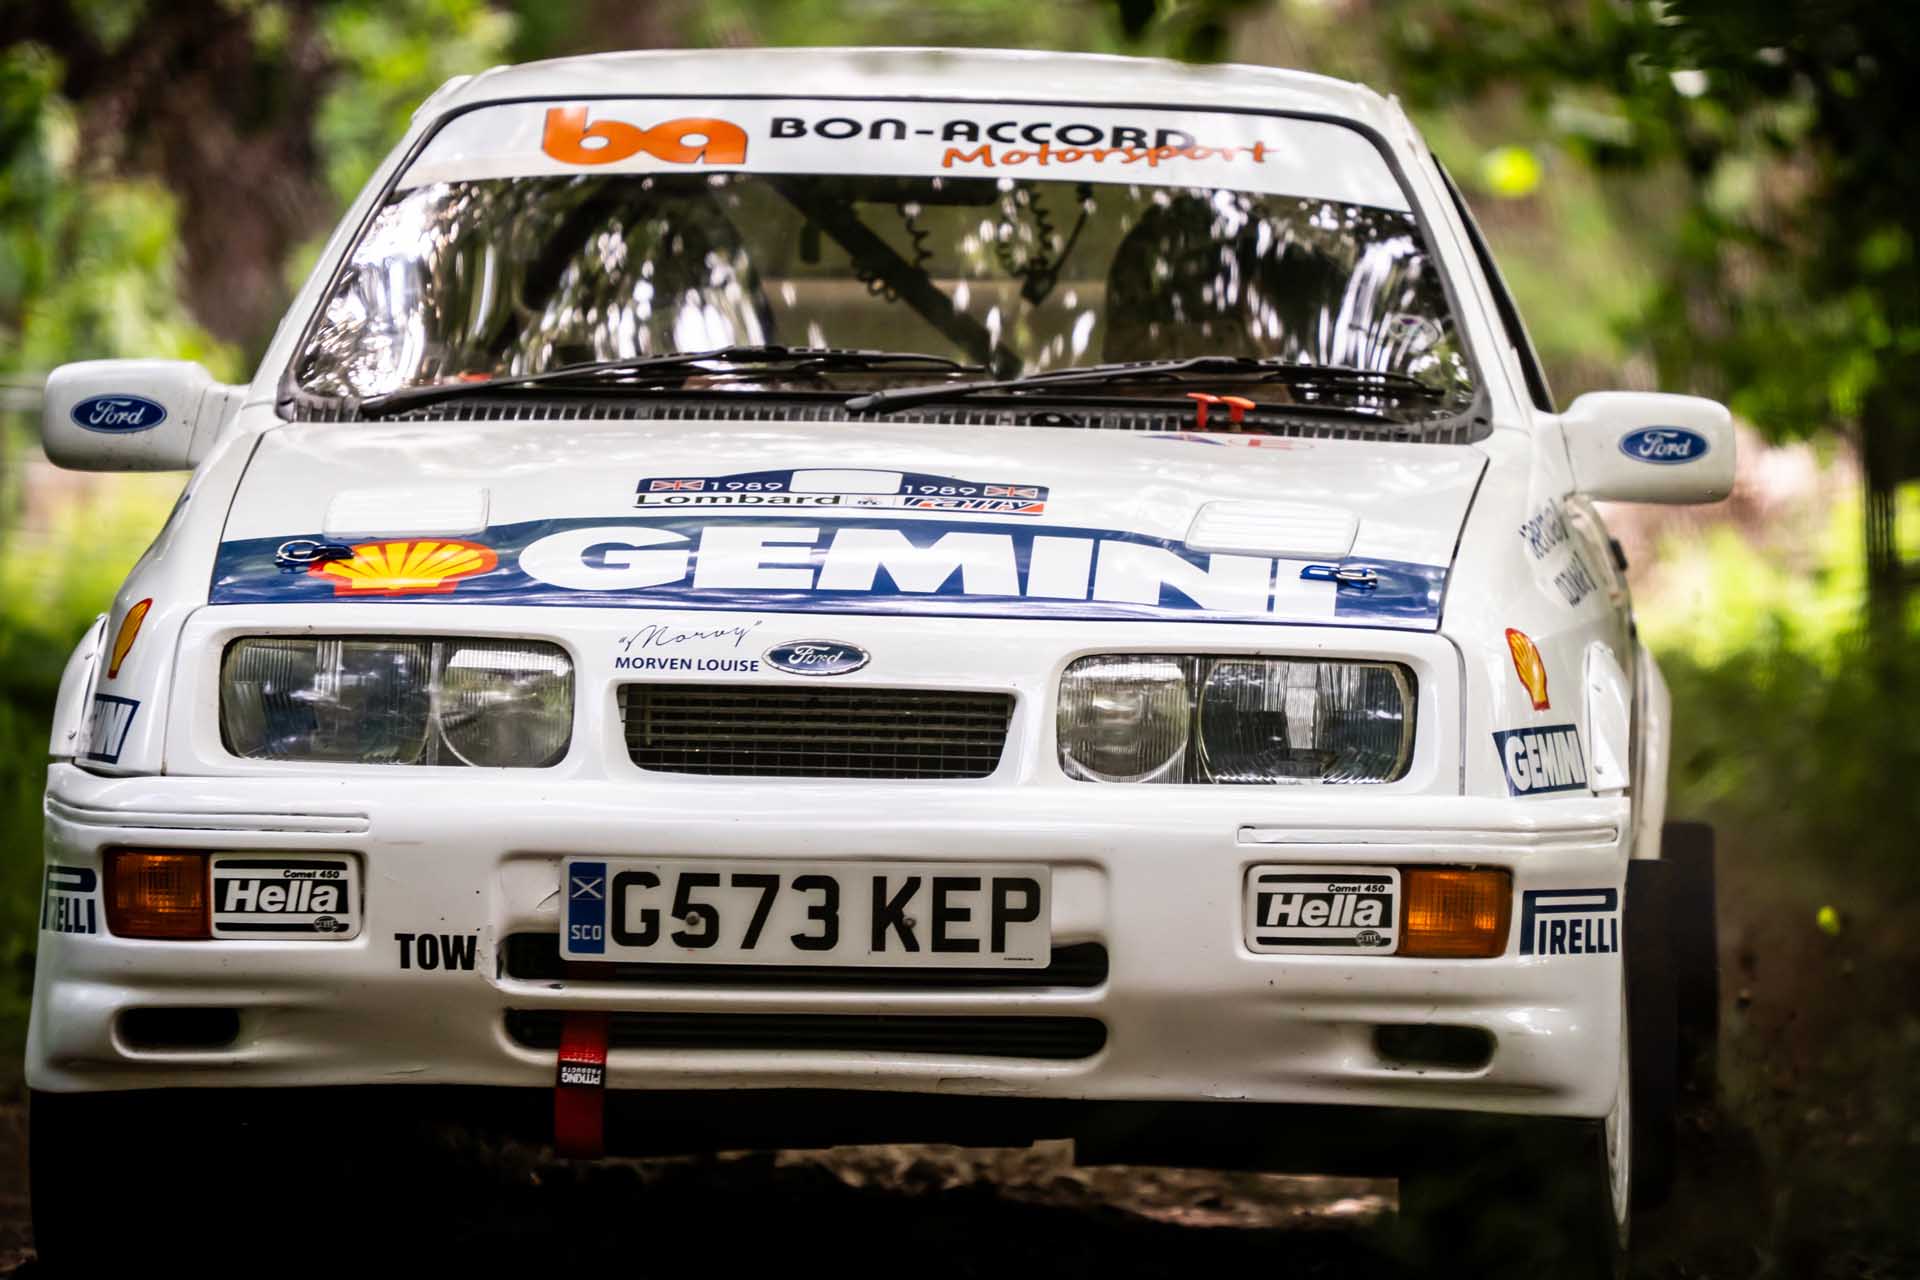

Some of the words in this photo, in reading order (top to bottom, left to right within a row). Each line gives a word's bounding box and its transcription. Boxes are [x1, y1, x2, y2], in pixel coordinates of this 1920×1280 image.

[942, 141, 1276, 168] Motorsport
[90, 400, 145, 425] Ford
[1640, 431, 1691, 456] Ford
[710, 481, 783, 492] 1989
[905, 484, 977, 496] 1989
[637, 494, 841, 506] Lombard
[519, 526, 1337, 616] GEMINI
[615, 656, 692, 671] MORVEN
[697, 657, 759, 672] LOUISE
[789, 646, 844, 664] Ford
[320, 870, 339, 879] 450
[42, 865, 96, 934] PELLI
[224, 880, 338, 912] Hella
[1327, 884, 1361, 893] Comet
[1365, 884, 1385, 893] 450
[611, 871, 839, 951] G573
[872, 876, 1041, 953] KEP
[1266, 894, 1382, 926] Hella
[1520, 888, 1618, 956] PIRELLI
[571, 924, 602, 941] SCO
[394, 933, 478, 970] TOW
